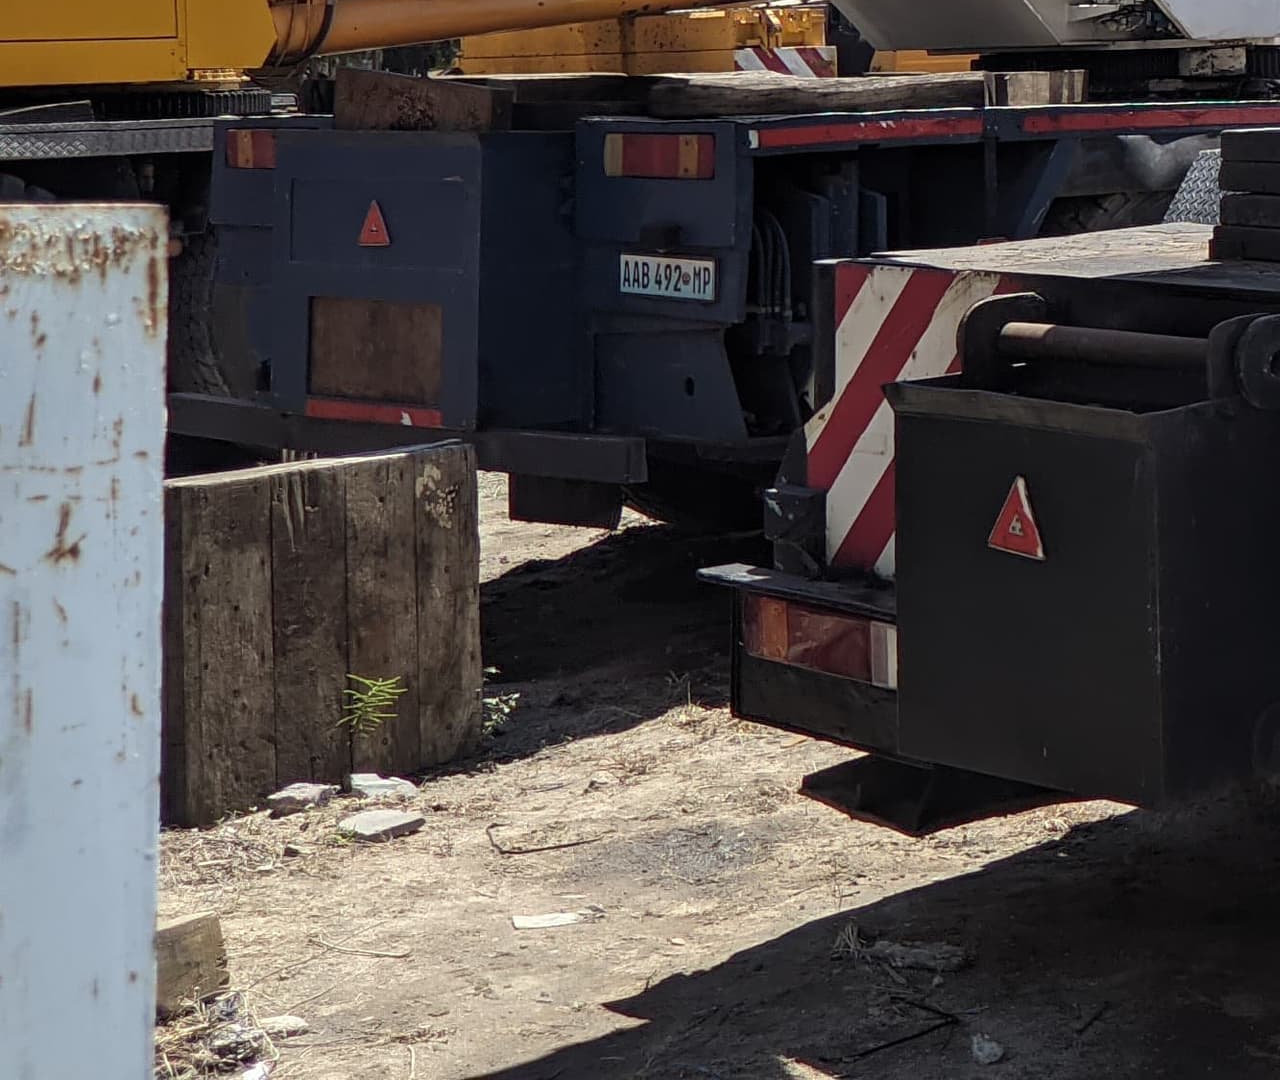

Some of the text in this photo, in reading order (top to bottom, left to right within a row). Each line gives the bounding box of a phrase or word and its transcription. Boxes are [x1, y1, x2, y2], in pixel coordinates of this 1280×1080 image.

[623, 260, 711, 295] AAB 492 MP
